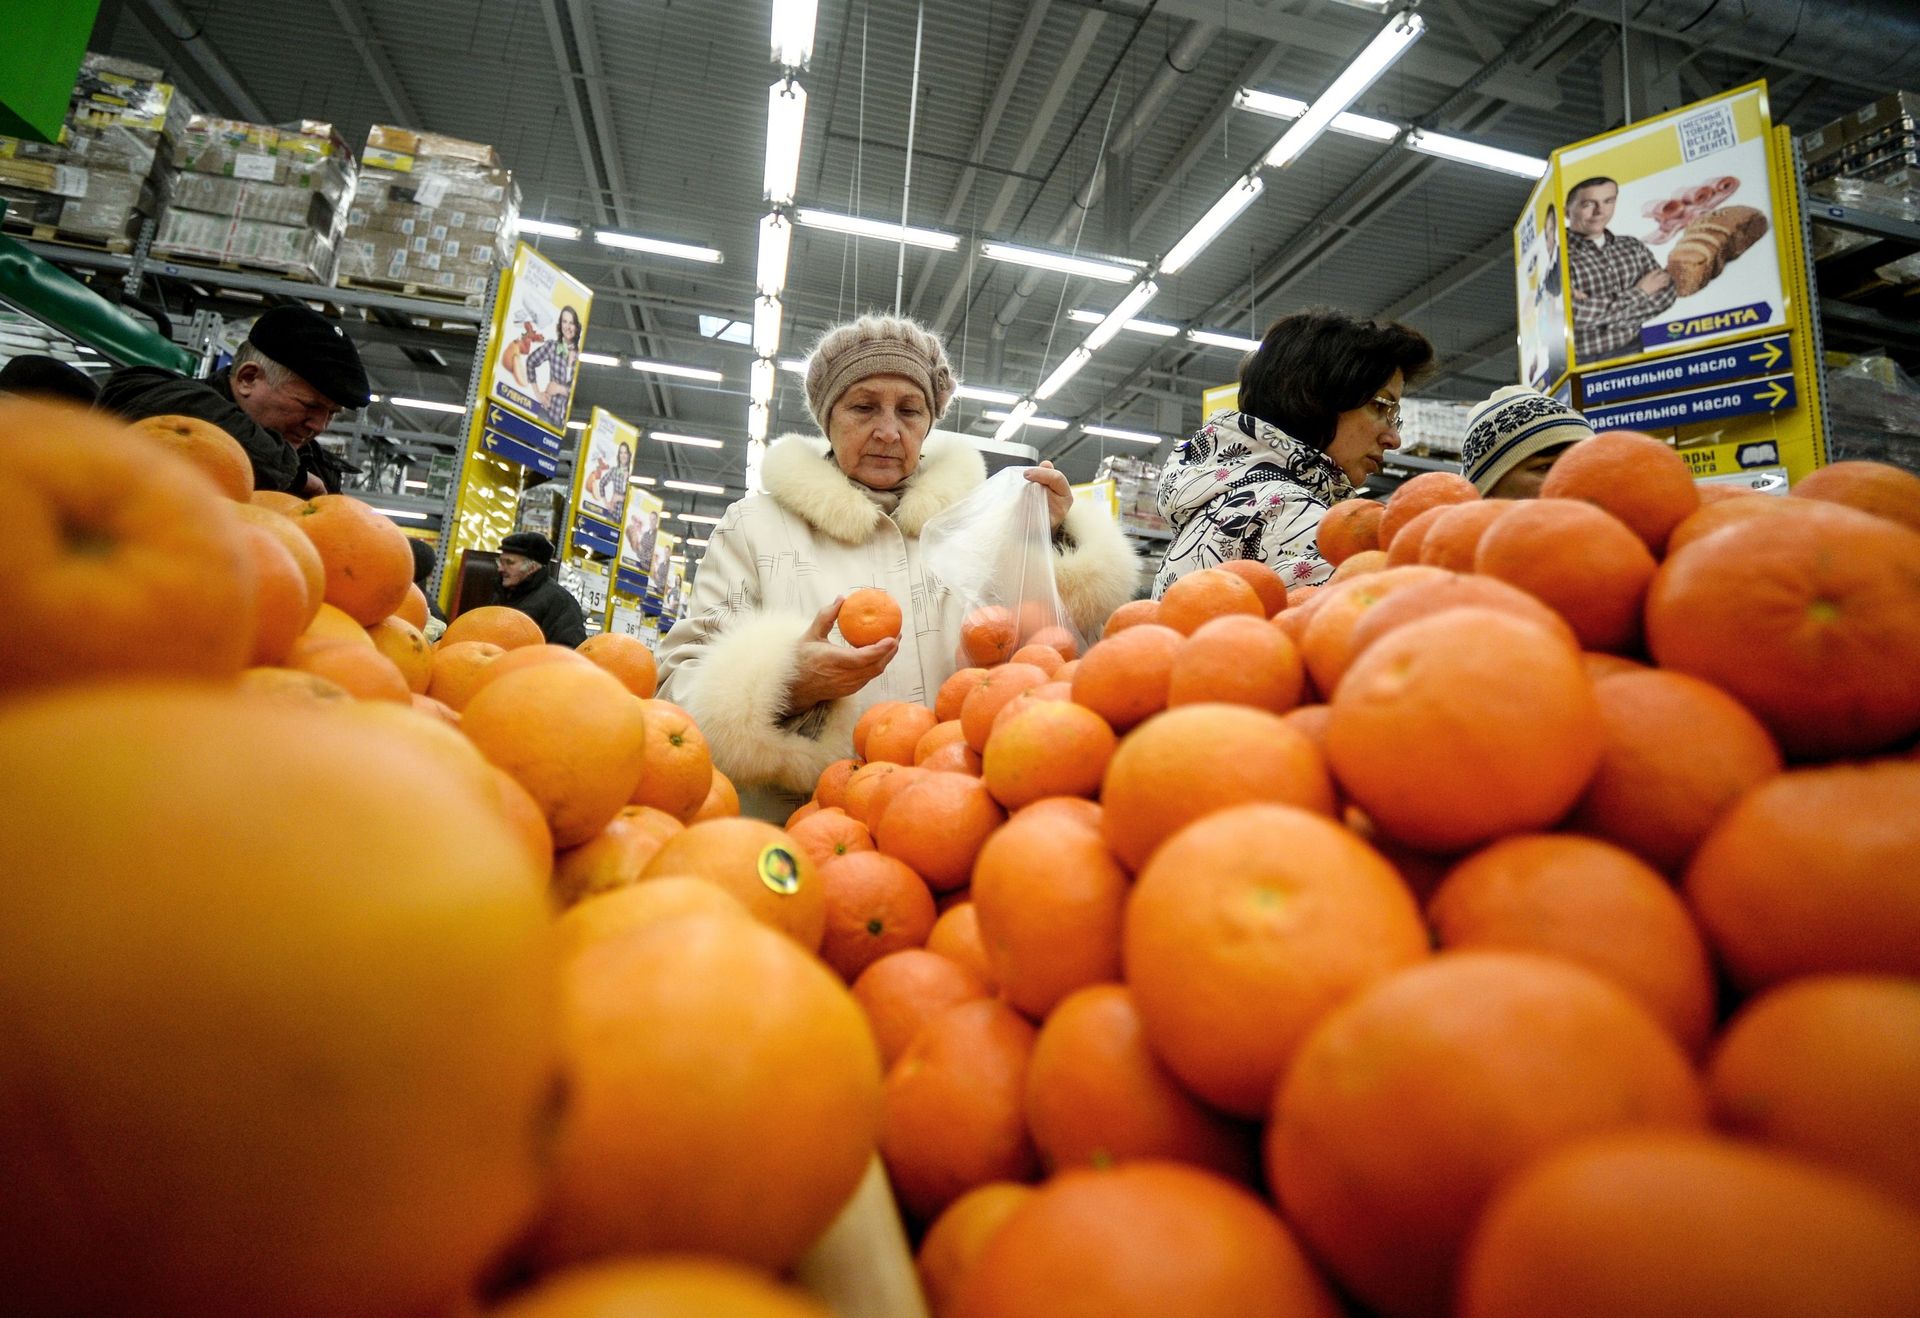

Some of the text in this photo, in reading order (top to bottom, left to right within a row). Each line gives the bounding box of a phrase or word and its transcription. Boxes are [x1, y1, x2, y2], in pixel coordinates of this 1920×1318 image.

[1686, 118, 1725, 137] ТОВАРЫ
[1687, 127, 1727, 147] ВСЕГДА
[1685, 308, 1759, 335] ЛЕНТА
[1586, 356, 1737, 397] растительное масло
[1692, 394, 1741, 413] масло
[1682, 450, 1715, 465] ары
